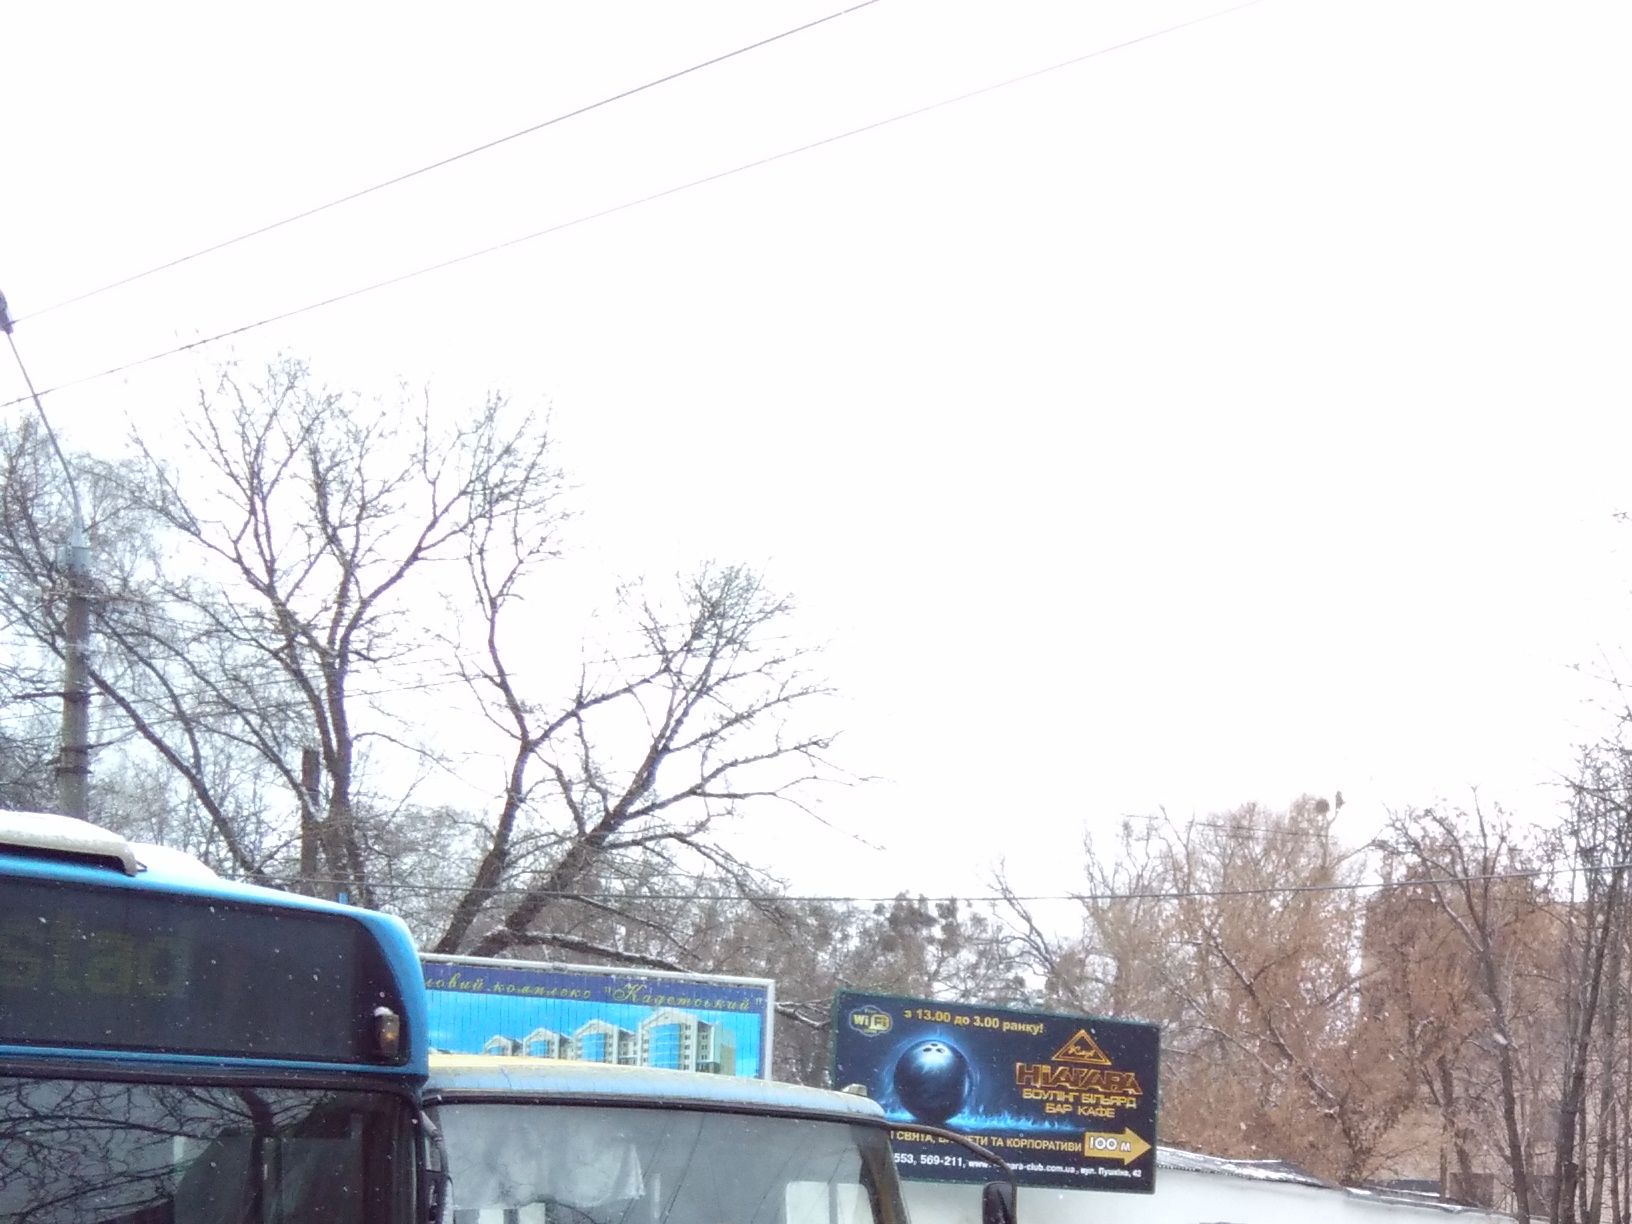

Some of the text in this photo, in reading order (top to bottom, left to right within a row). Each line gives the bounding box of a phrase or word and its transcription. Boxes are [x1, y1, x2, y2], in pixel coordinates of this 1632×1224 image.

[916, 1008, 951, 1022] 13.00
[954, 1015, 970, 1026] до
[973, 1015, 1000, 1028] 3.00
[1002, 1021, 1044, 1035] ранку!
[1022, 1088, 1137, 1109] БОУЛІНГ БІЛЬЯРД
[1045, 1102, 1115, 1118] БАР КАФЕ
[991, 1136, 1005, 1147] ТА
[1005, 1138, 1082, 1152] КОРПОРАТИВИ
[1089, 1135, 1117, 1150] 100
[920, 1154, 966, 1168] 569-211,
